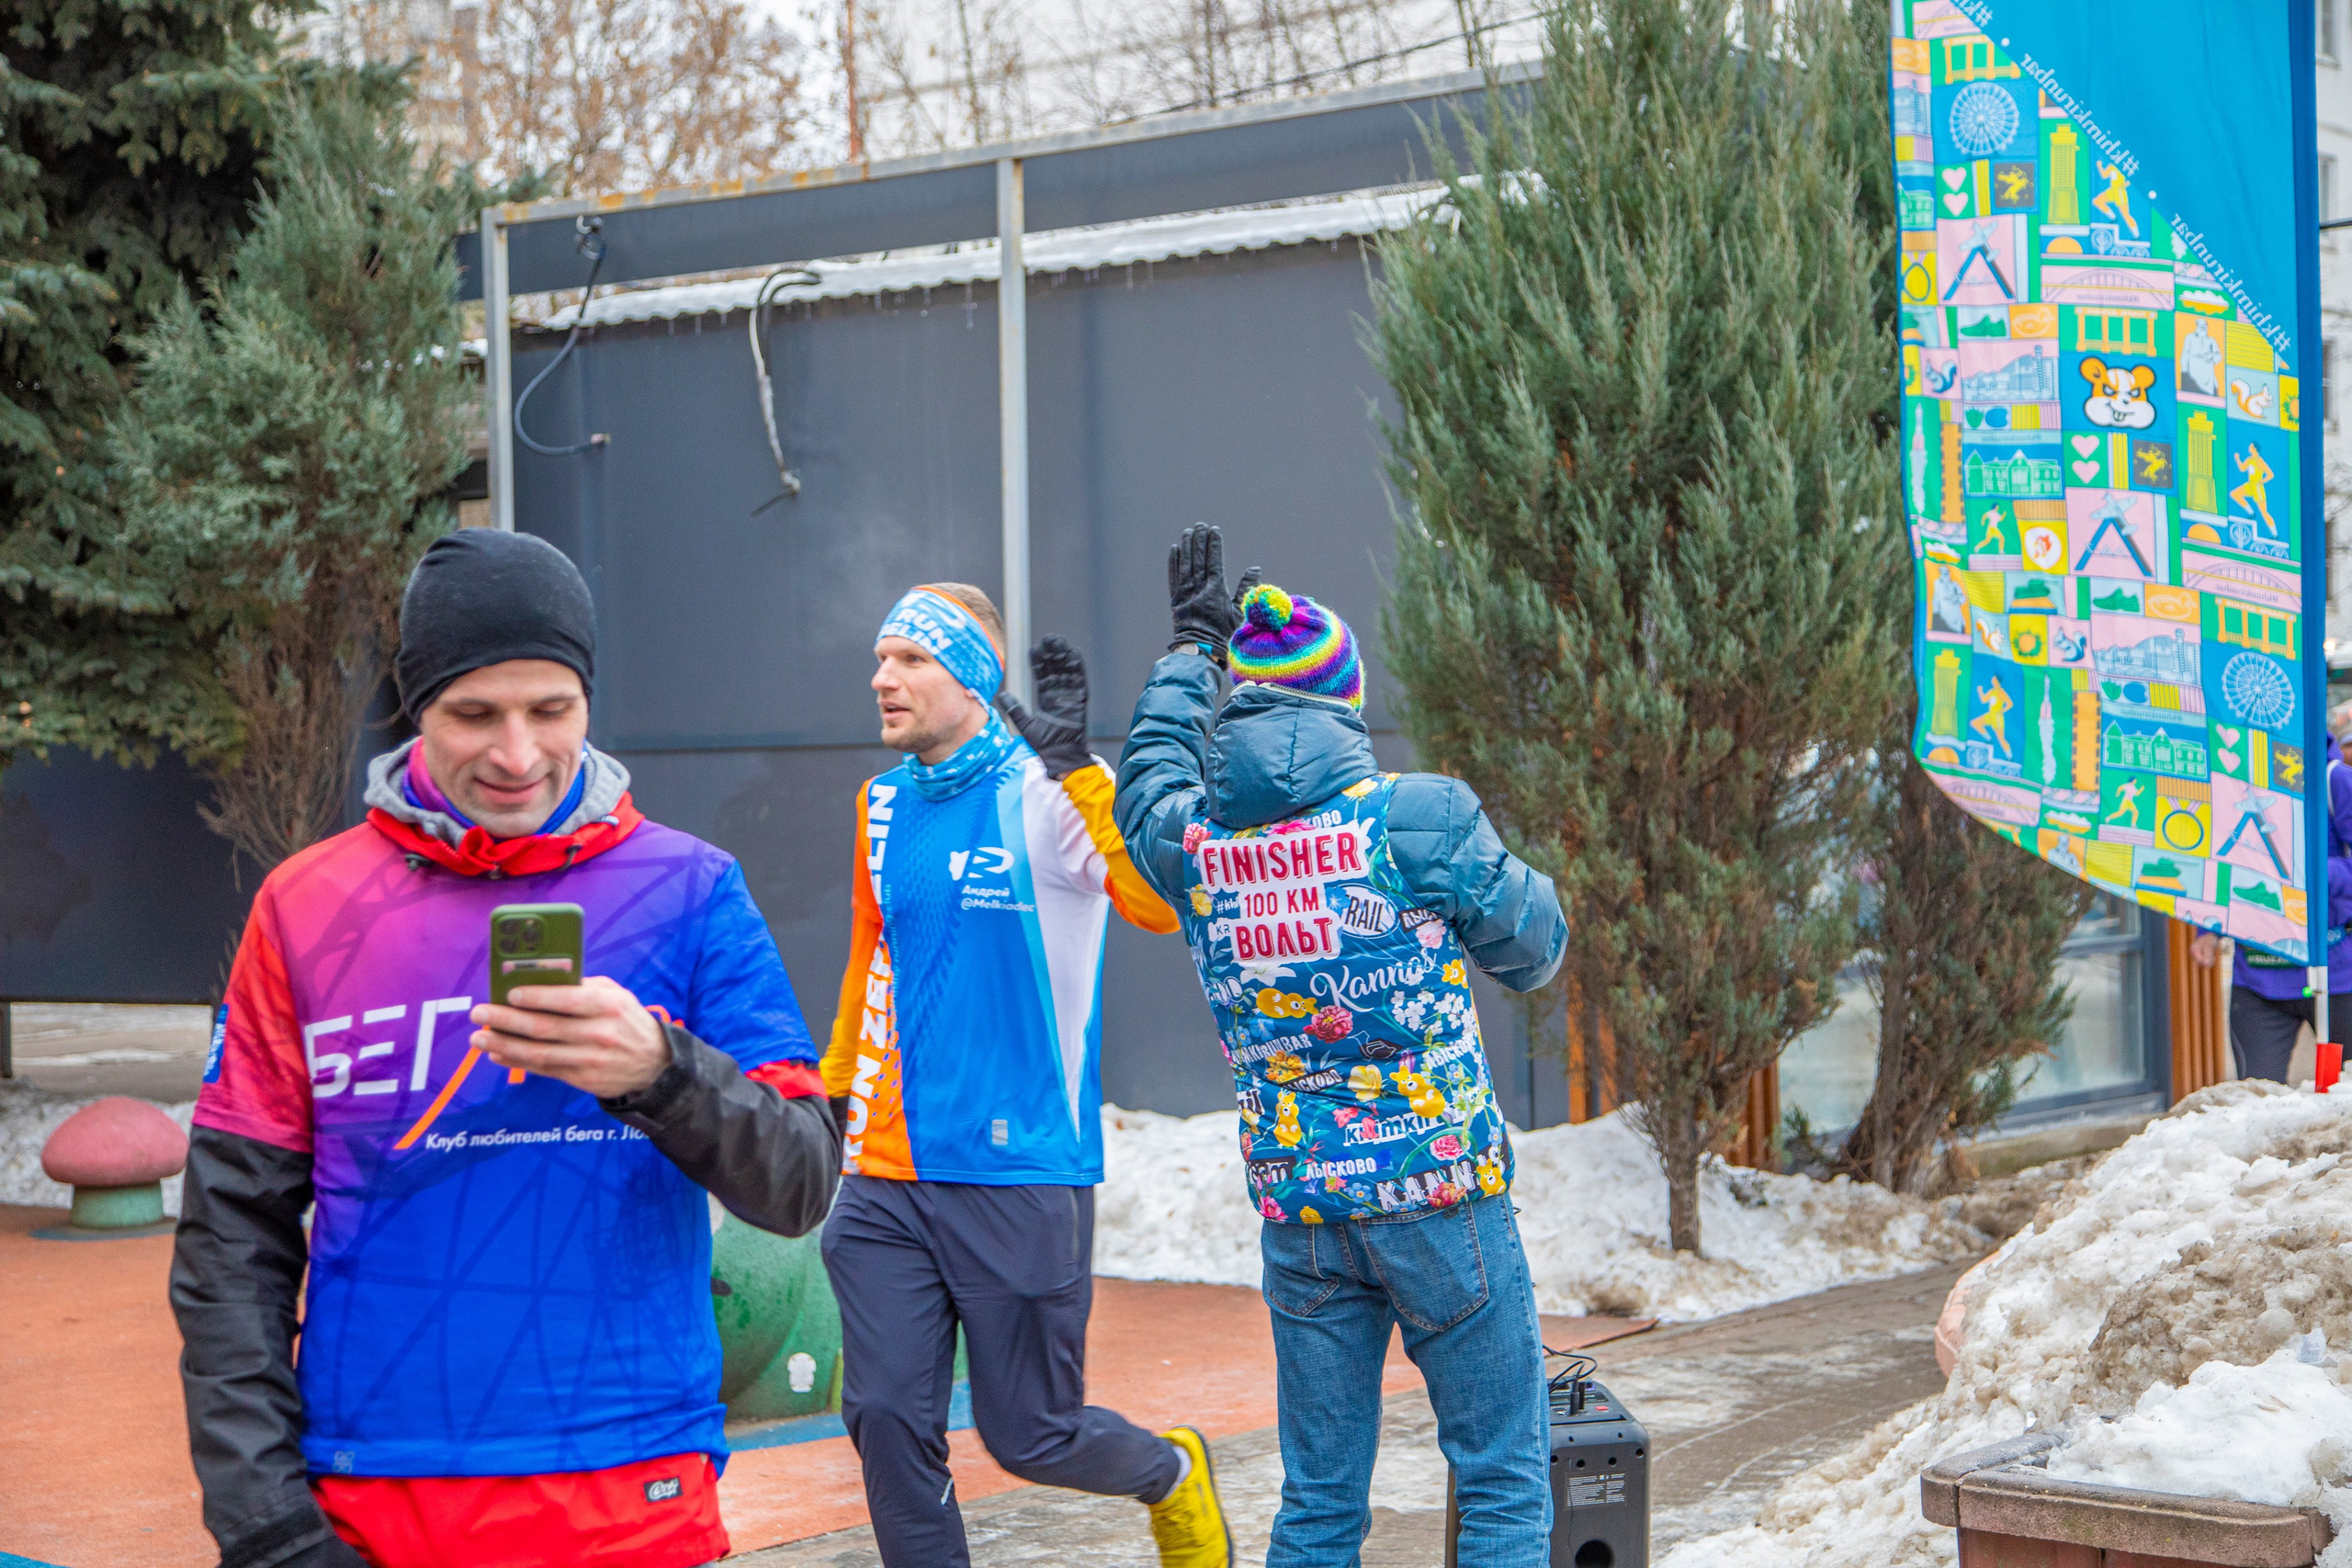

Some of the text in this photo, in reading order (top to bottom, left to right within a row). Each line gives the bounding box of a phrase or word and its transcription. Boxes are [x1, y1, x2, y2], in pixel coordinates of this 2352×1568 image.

[894, 608, 954, 651] RUN
[1203, 832, 1362, 887] FINISHER
[961, 885, 1011, 897] Андрей
[1244, 886, 1319, 919] 100 КМ
[1236, 917, 1333, 961] ВОЛЬТ
[425, 1131, 469, 1153] Клуб
[469, 1126, 561, 1147] любителей
[565, 1124, 603, 1142] бега
[606, 1129, 617, 1140] г.
[1306, 1156, 1377, 1180] ЛЫСКОВО
